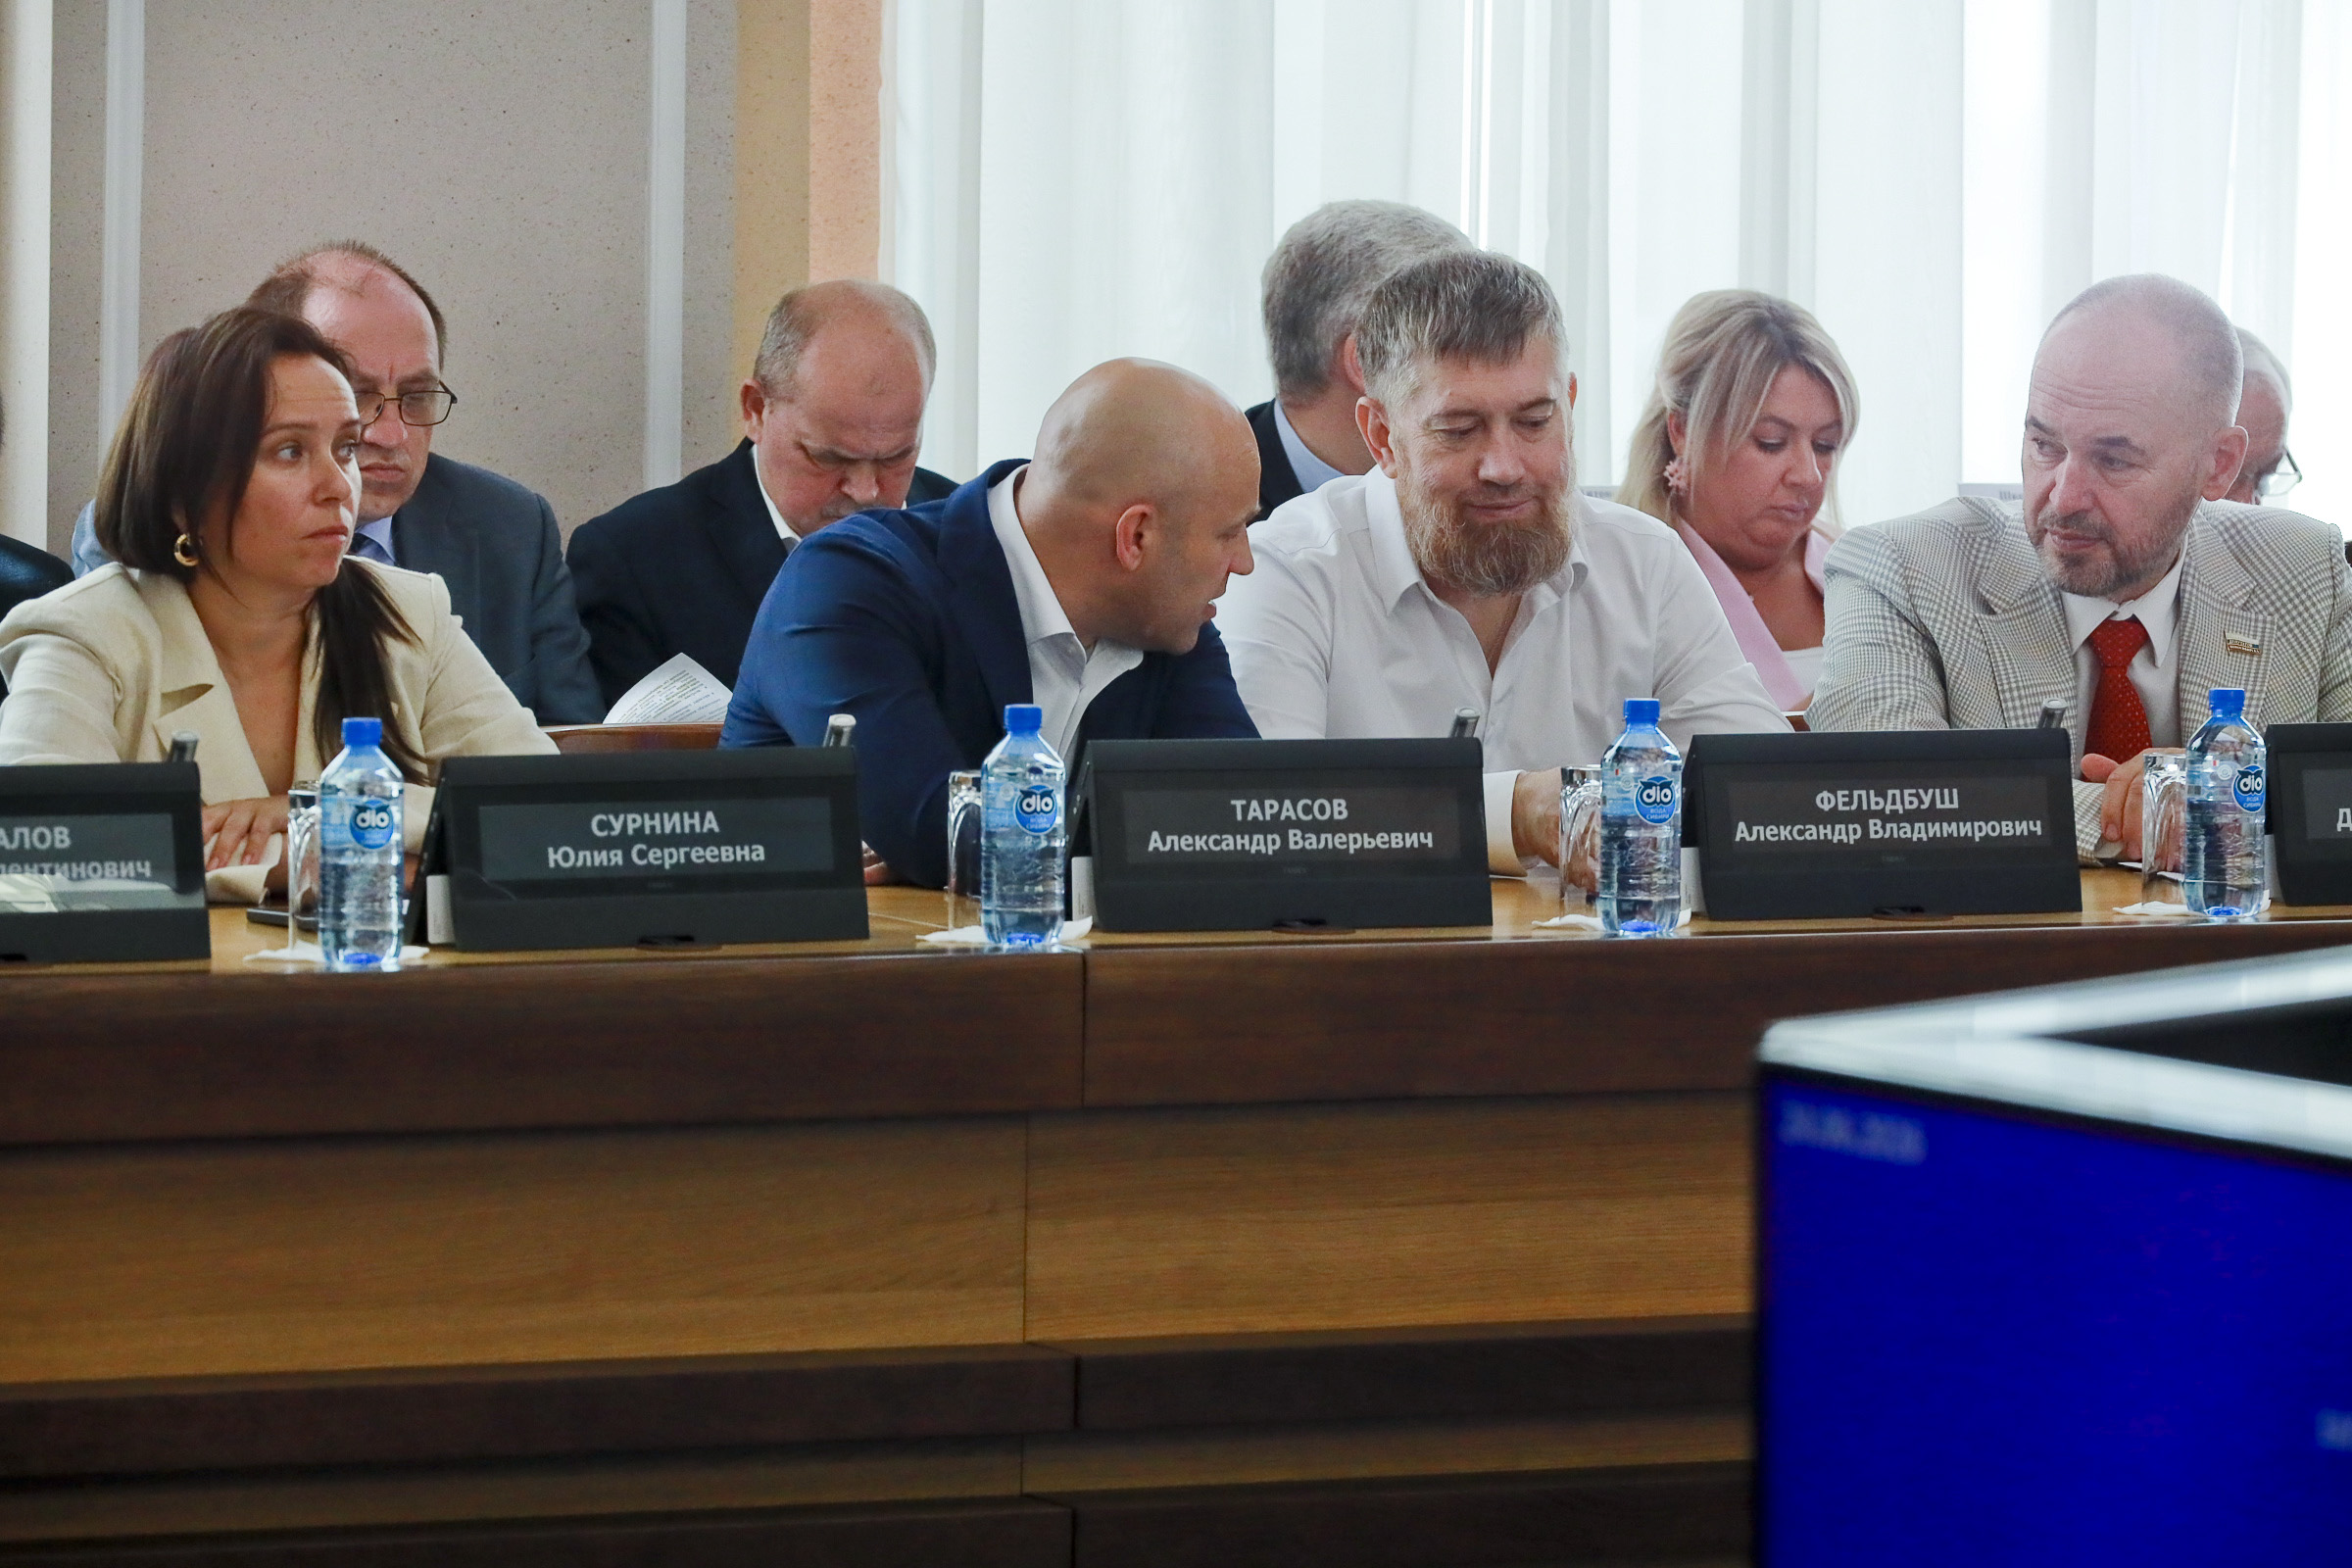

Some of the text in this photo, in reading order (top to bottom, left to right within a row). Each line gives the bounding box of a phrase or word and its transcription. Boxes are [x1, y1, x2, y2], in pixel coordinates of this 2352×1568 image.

[1230, 798, 1349, 821] ТАРАСОВ
[1815, 788, 1960, 814] ФЕЛЬДБУШ
[590, 810, 720, 837] СУРНИНА
[1735, 818, 2042, 845] Александр Владимирович
[1148, 829, 1434, 856] Александр Валерьевич
[547, 844, 766, 870] Юлия Сергеевна
